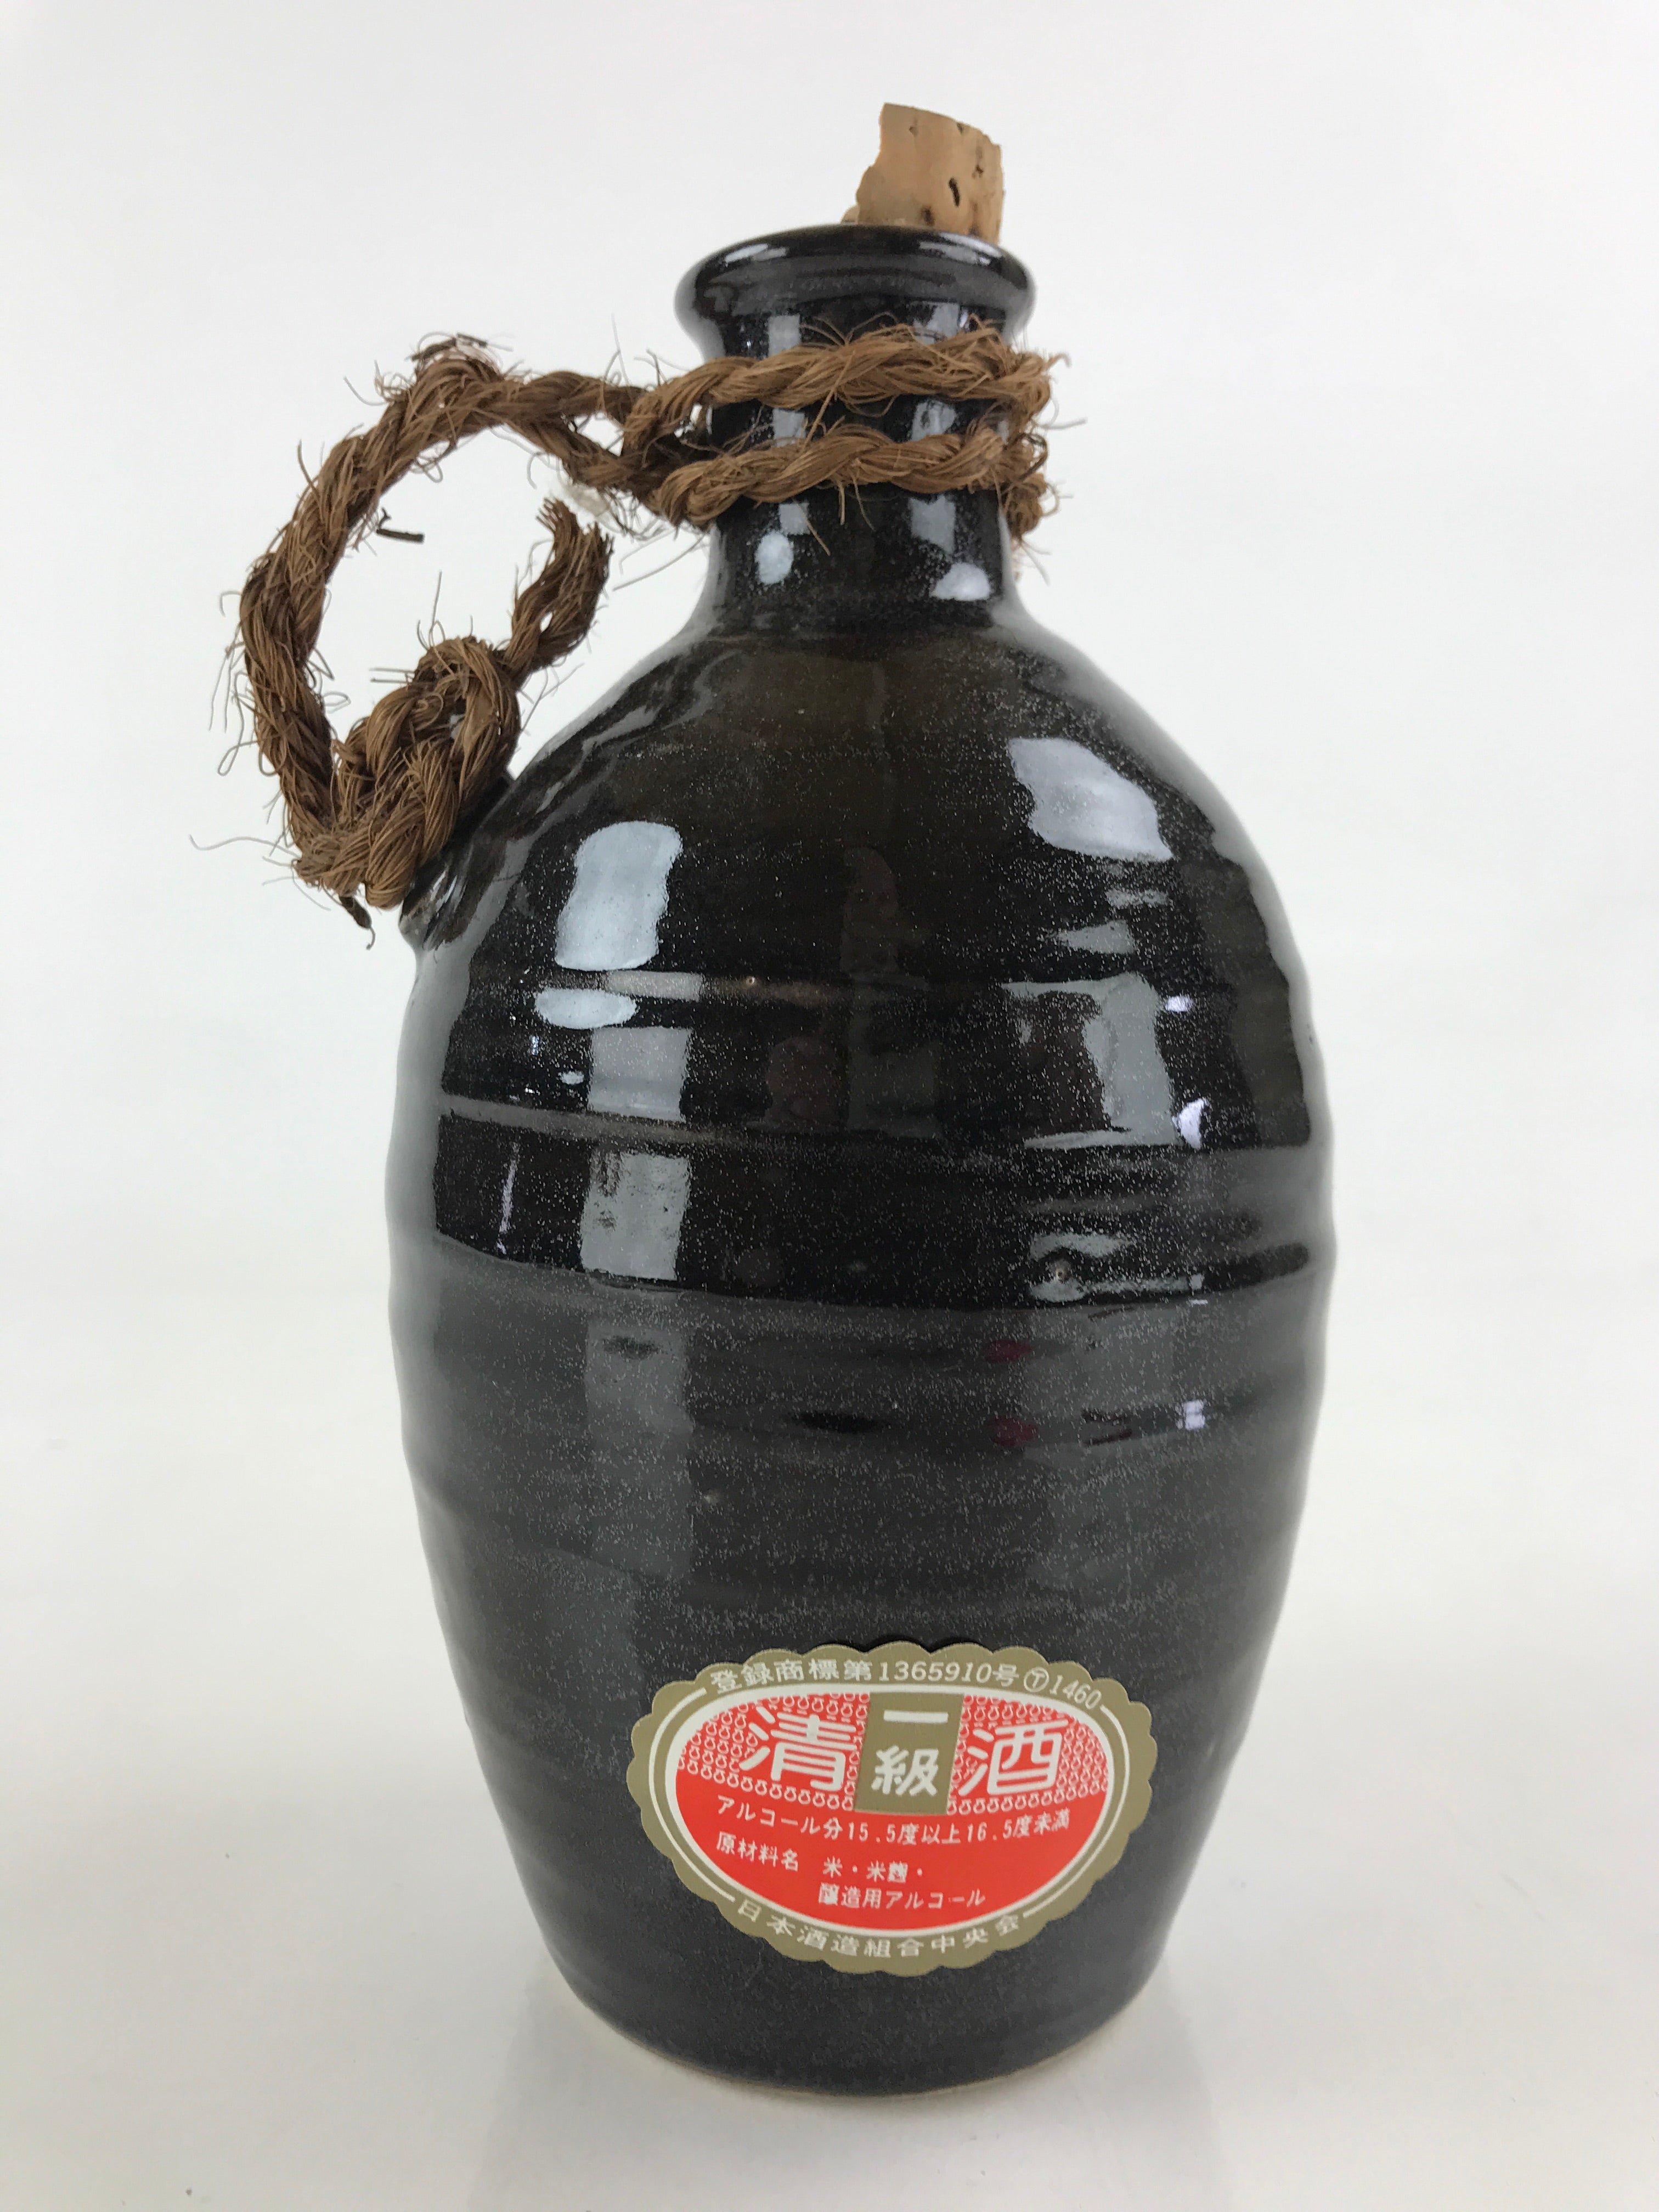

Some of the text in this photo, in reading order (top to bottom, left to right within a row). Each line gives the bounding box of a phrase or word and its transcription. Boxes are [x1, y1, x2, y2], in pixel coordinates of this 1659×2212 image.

[740, 1706, 857, 1795] 清
[958, 1719, 1069, 1796] 酒
[716, 1831, 799, 1872] 原材料名
